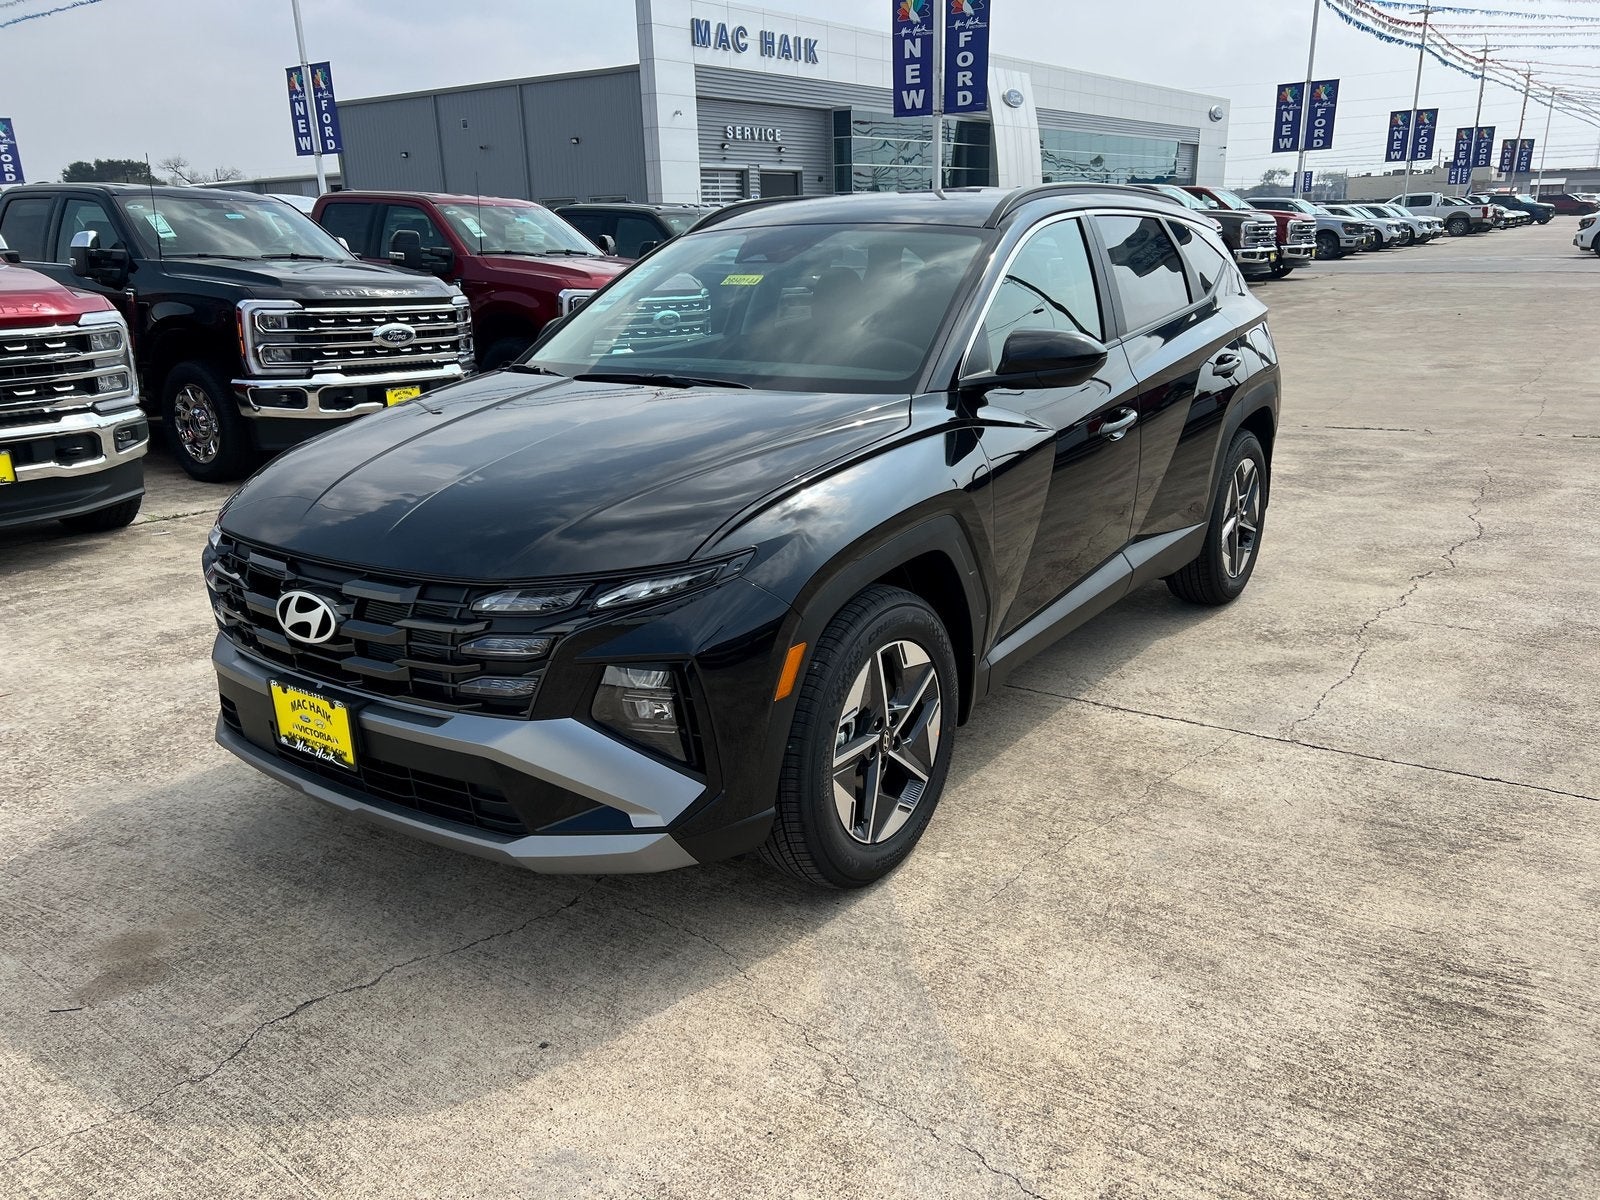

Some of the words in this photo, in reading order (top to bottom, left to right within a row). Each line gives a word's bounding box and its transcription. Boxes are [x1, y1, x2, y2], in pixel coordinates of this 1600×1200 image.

[690, 17, 748, 53] MAC
[760, 30, 819, 64] HAIK
[902, 38, 925, 109] NEW
[956, 31, 974, 106] FORD
[294, 102, 311, 150] NEW
[321, 100, 336, 150] FORD
[726, 125, 781, 141] SERVICE
[1279, 110, 1293, 149] NEW
[1313, 108, 1327, 148] FORD
[1390, 130, 1403, 160] NEW
[1417, 129, 1428, 159] FORD
[1456, 143, 1467, 166] NEW
[1478, 142, 1488, 166] FORD
[0, 144, 16, 181] FORD
[1502, 152, 1511, 171] NEW
[1519, 151, 1528, 171] FORD
[387, 331, 407, 341] Ford
[290, 699, 308, 713] MAC
